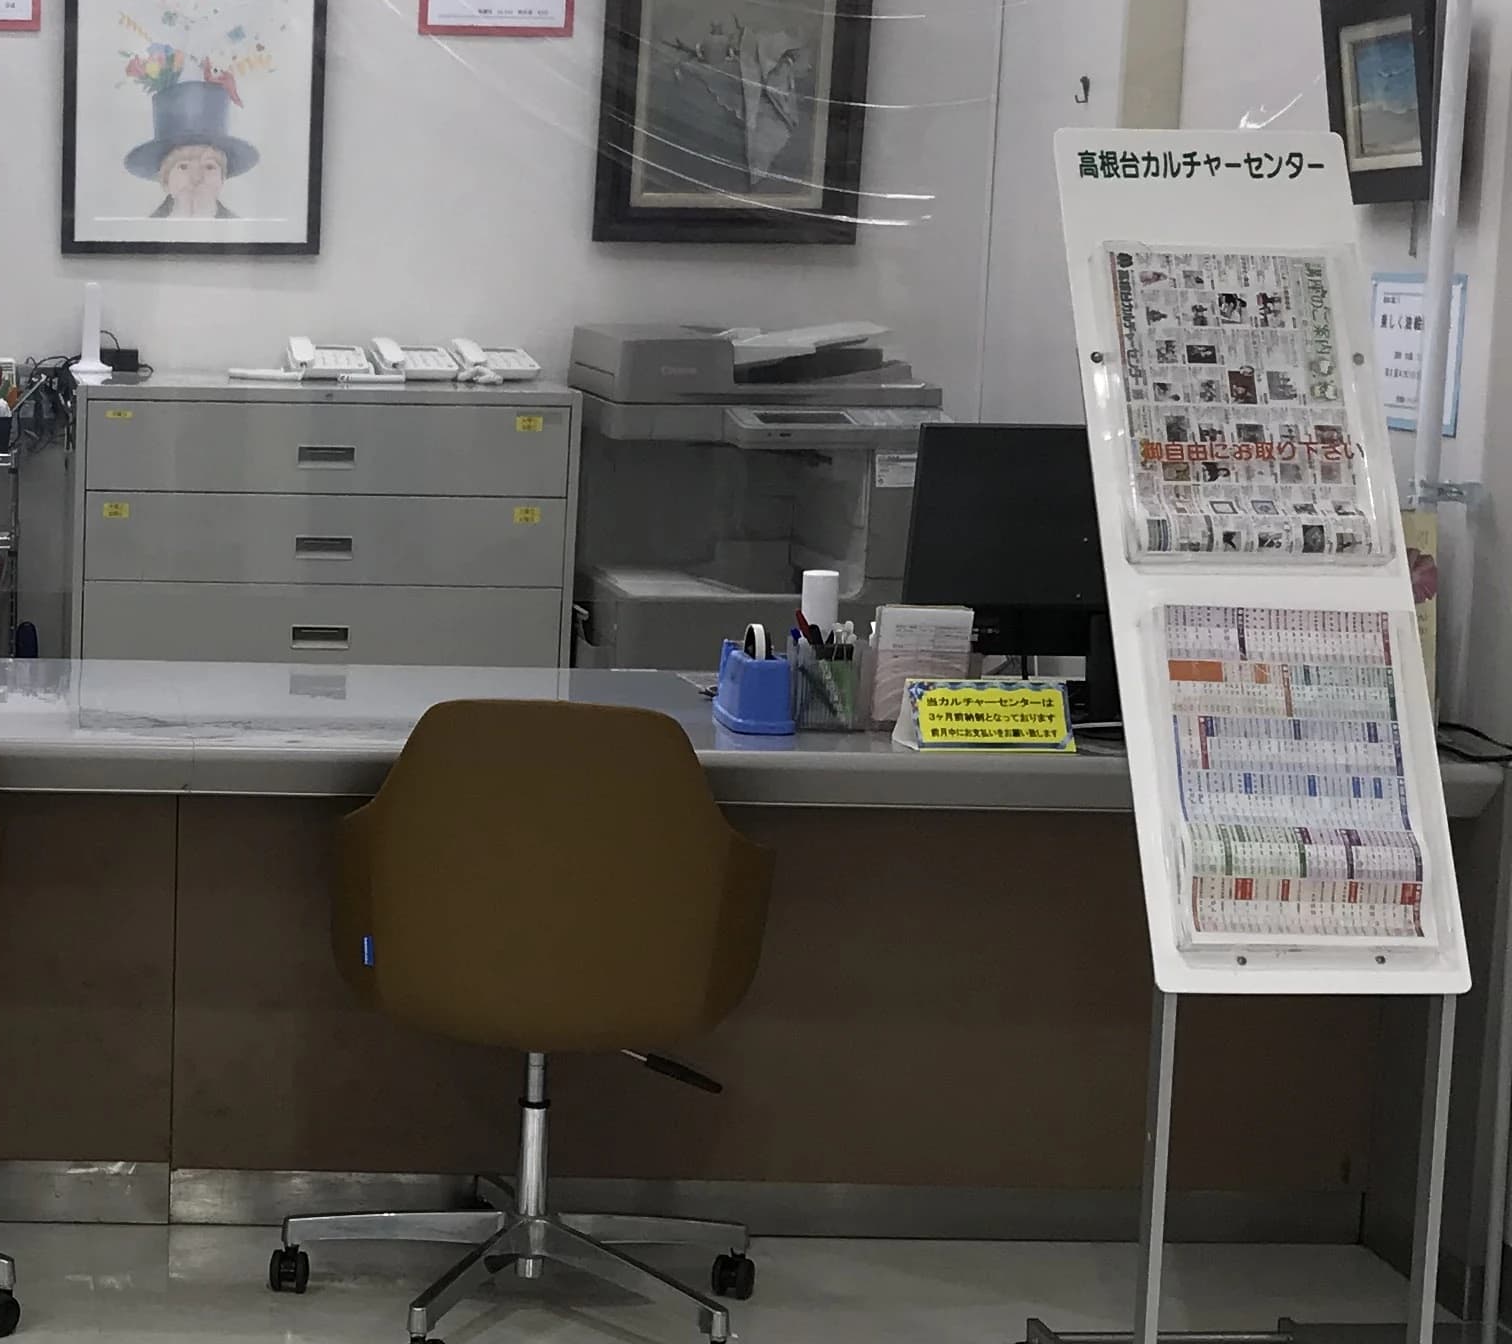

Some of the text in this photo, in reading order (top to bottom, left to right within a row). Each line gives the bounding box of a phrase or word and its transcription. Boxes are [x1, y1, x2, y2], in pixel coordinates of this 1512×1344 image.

[1077, 150, 1325, 180] 高根台カルチャーセンター
